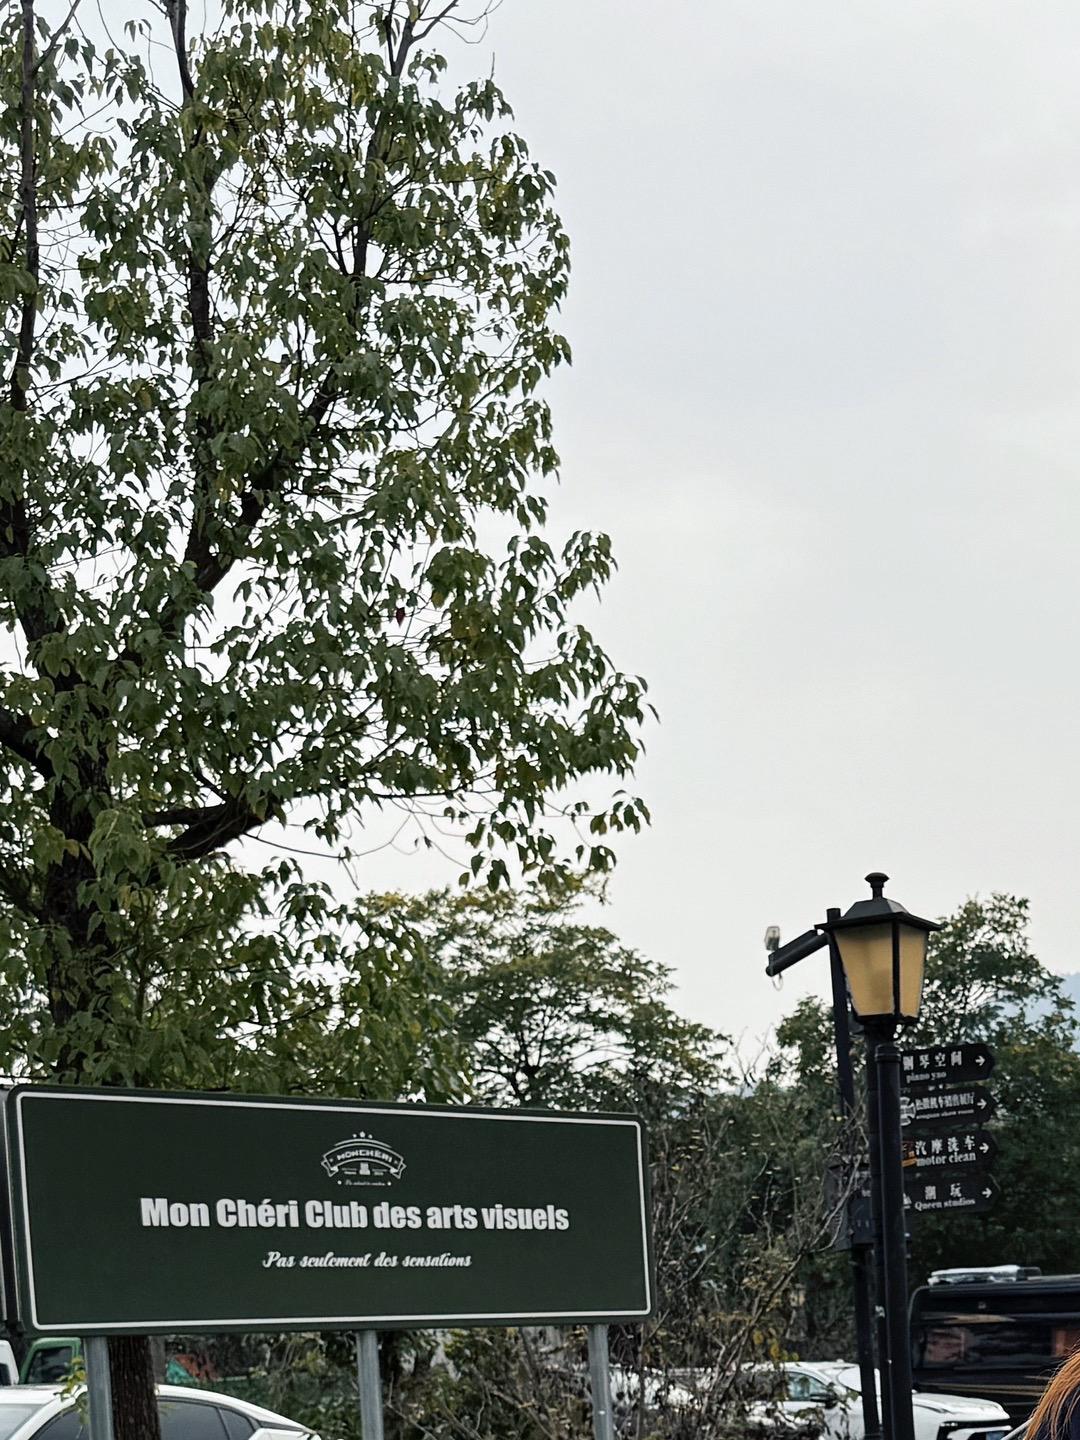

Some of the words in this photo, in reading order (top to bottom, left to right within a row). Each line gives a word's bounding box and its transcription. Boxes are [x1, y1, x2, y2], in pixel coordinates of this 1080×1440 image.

[916, 1155, 947, 1167] motor
[948, 1152, 977, 1163] clean
[140, 1198, 210, 1227] Mon
[216, 1199, 300, 1228] Chéri
[305, 1200, 368, 1228] Club
[373, 1202, 422, 1229] des
[426, 1205, 478, 1229] arts
[481, 1204, 570, 1230] visuels
[915, 1201, 943, 1211] Queen
[262, 1251, 296, 1268] Pas
[299, 1252, 372, 1268] seulement
[374, 1252, 398, 1268] des
[402, 1253, 473, 1268] sensations
